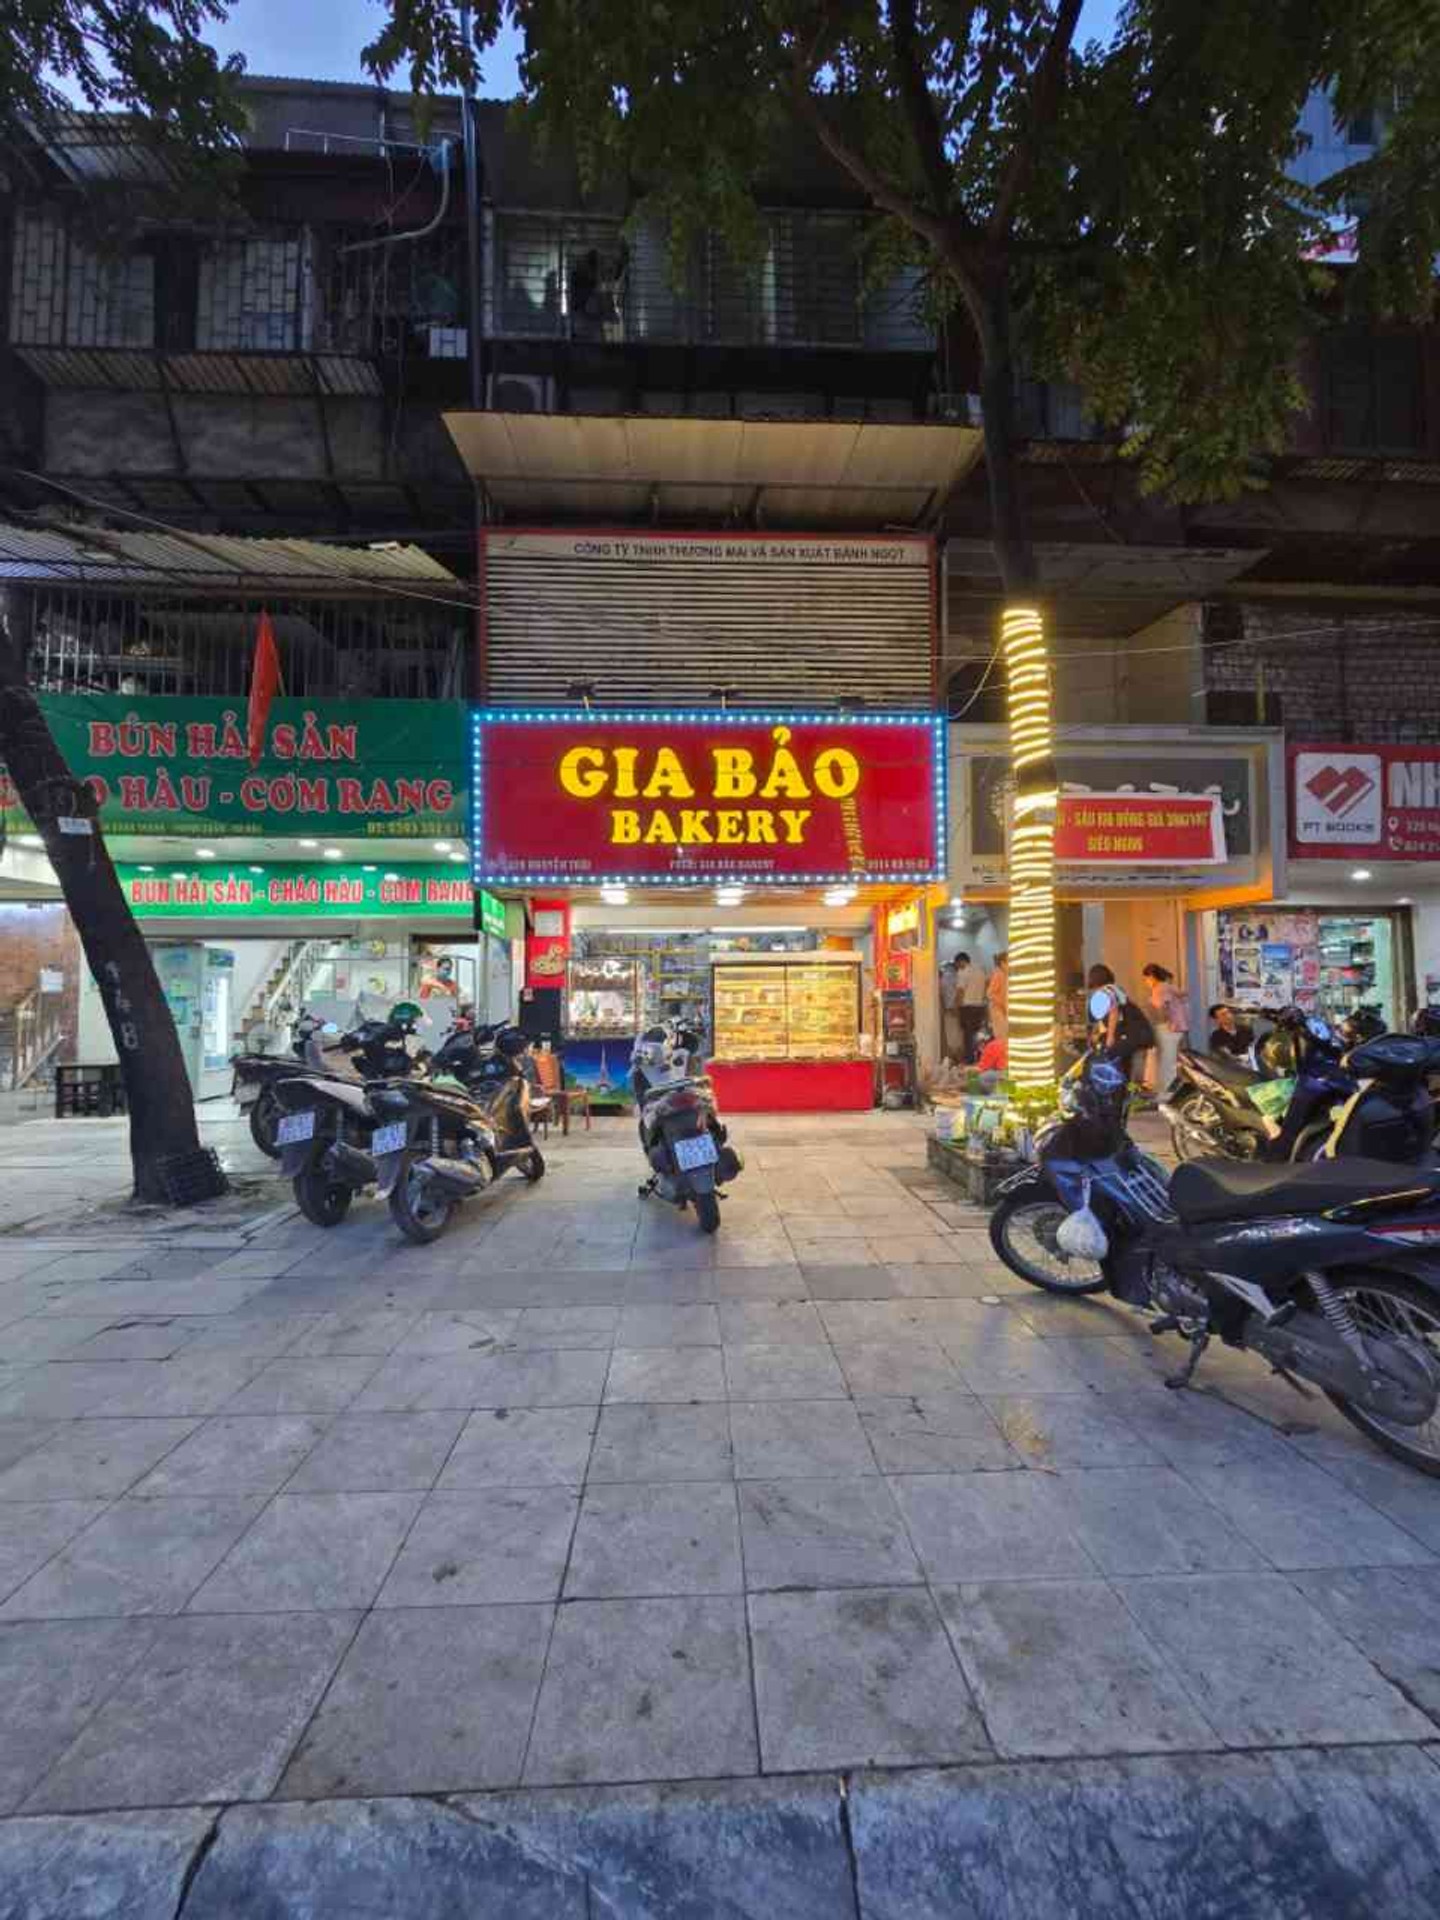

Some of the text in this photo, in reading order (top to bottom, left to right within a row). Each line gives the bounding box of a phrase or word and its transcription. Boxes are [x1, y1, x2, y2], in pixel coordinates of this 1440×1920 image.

[273, 711, 357, 760] SẢN
[559, 725, 861, 799] GIA BẢO
[119, 767, 212, 811] HÀU
[240, 768, 328, 813] CƠM
[338, 777, 454, 814] RANG
[610, 810, 813, 844] BAKERY
[1303, 822, 1374, 834] PT BOOKS
